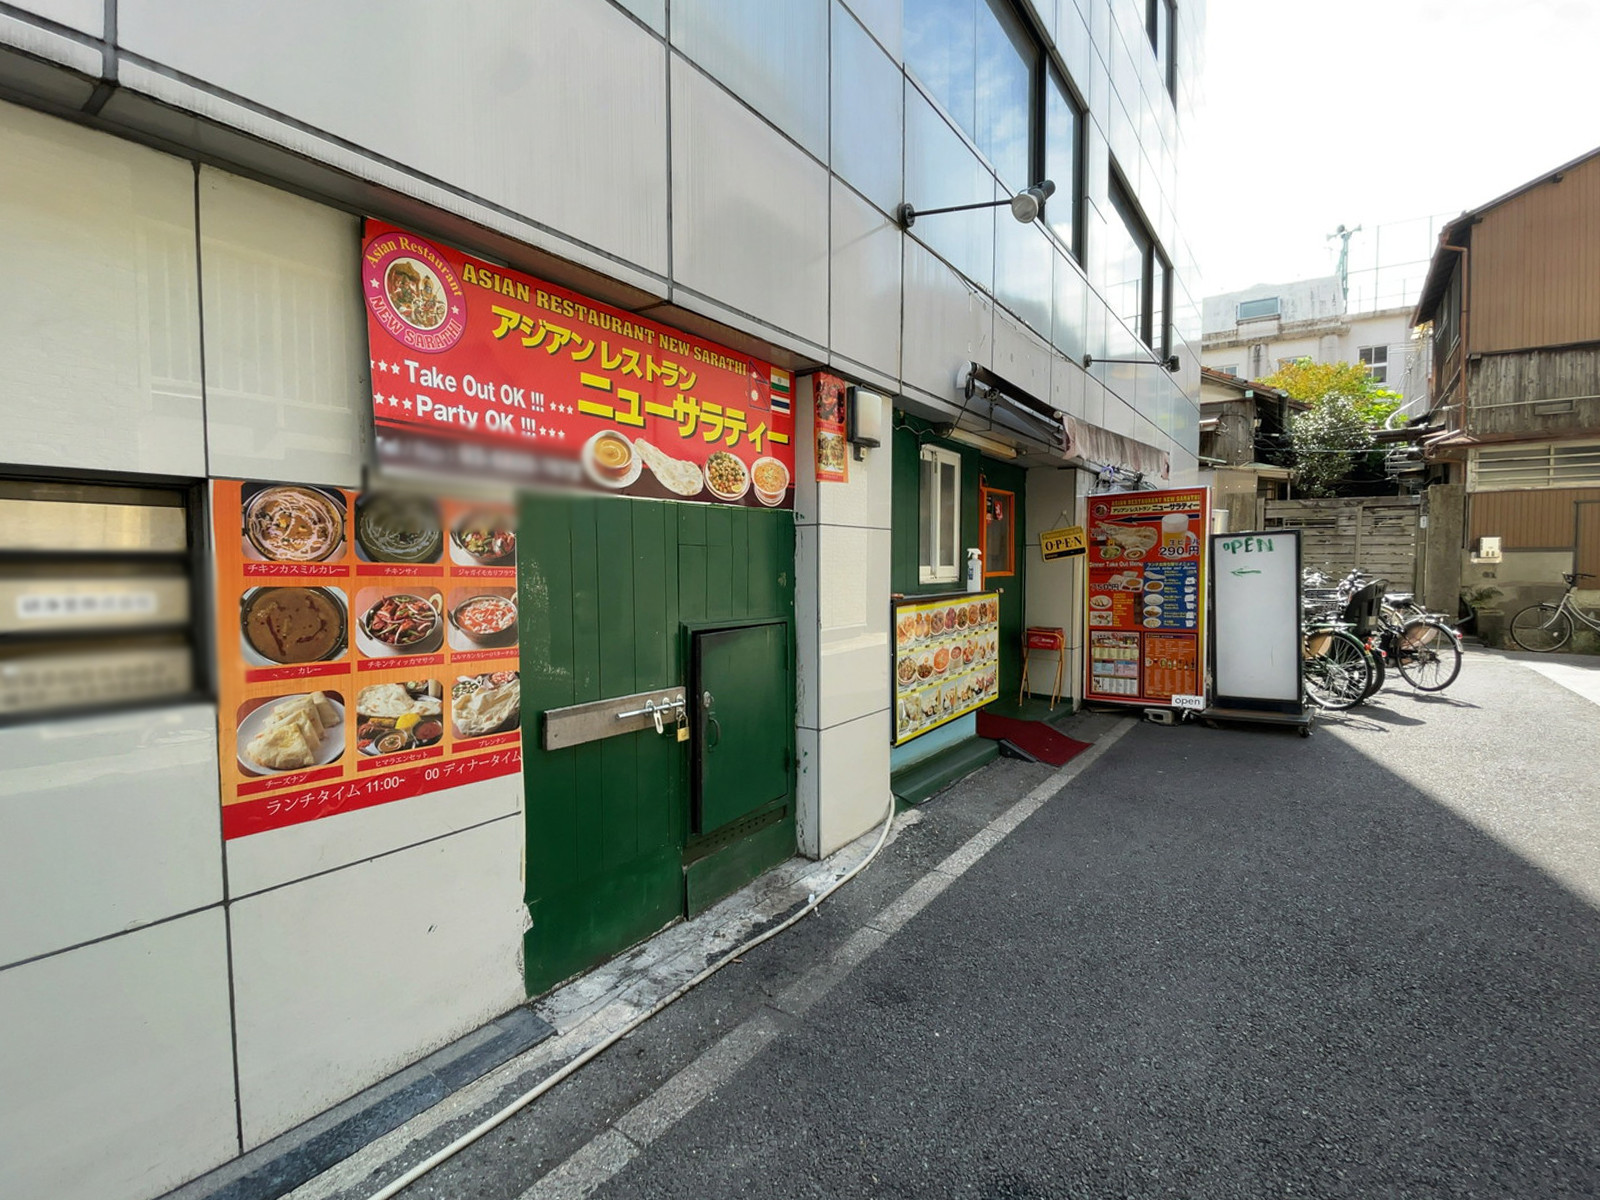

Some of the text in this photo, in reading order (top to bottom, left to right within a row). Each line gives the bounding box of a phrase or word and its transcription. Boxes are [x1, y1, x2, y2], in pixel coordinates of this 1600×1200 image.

[366, 236, 463, 296] Asian Restaurant
[369, 295, 462, 350] NEW SARATHI
[463, 263, 748, 377] ASIAN RESTAURANT NEW SARATHI
[404, 359, 457, 392] Take
[462, 374, 496, 402] Out
[500, 384, 526, 408] OK
[416, 394, 479, 430] Party
[485, 409, 515, 434] OK
[577, 372, 789, 453] ニューサラティー
[247, 564, 346, 574] チキンカスミルカレー
[1174, 697, 1201, 706] open
[266, 784, 361, 816] ランチタイム
[443, 750, 522, 777] ディナータイム
